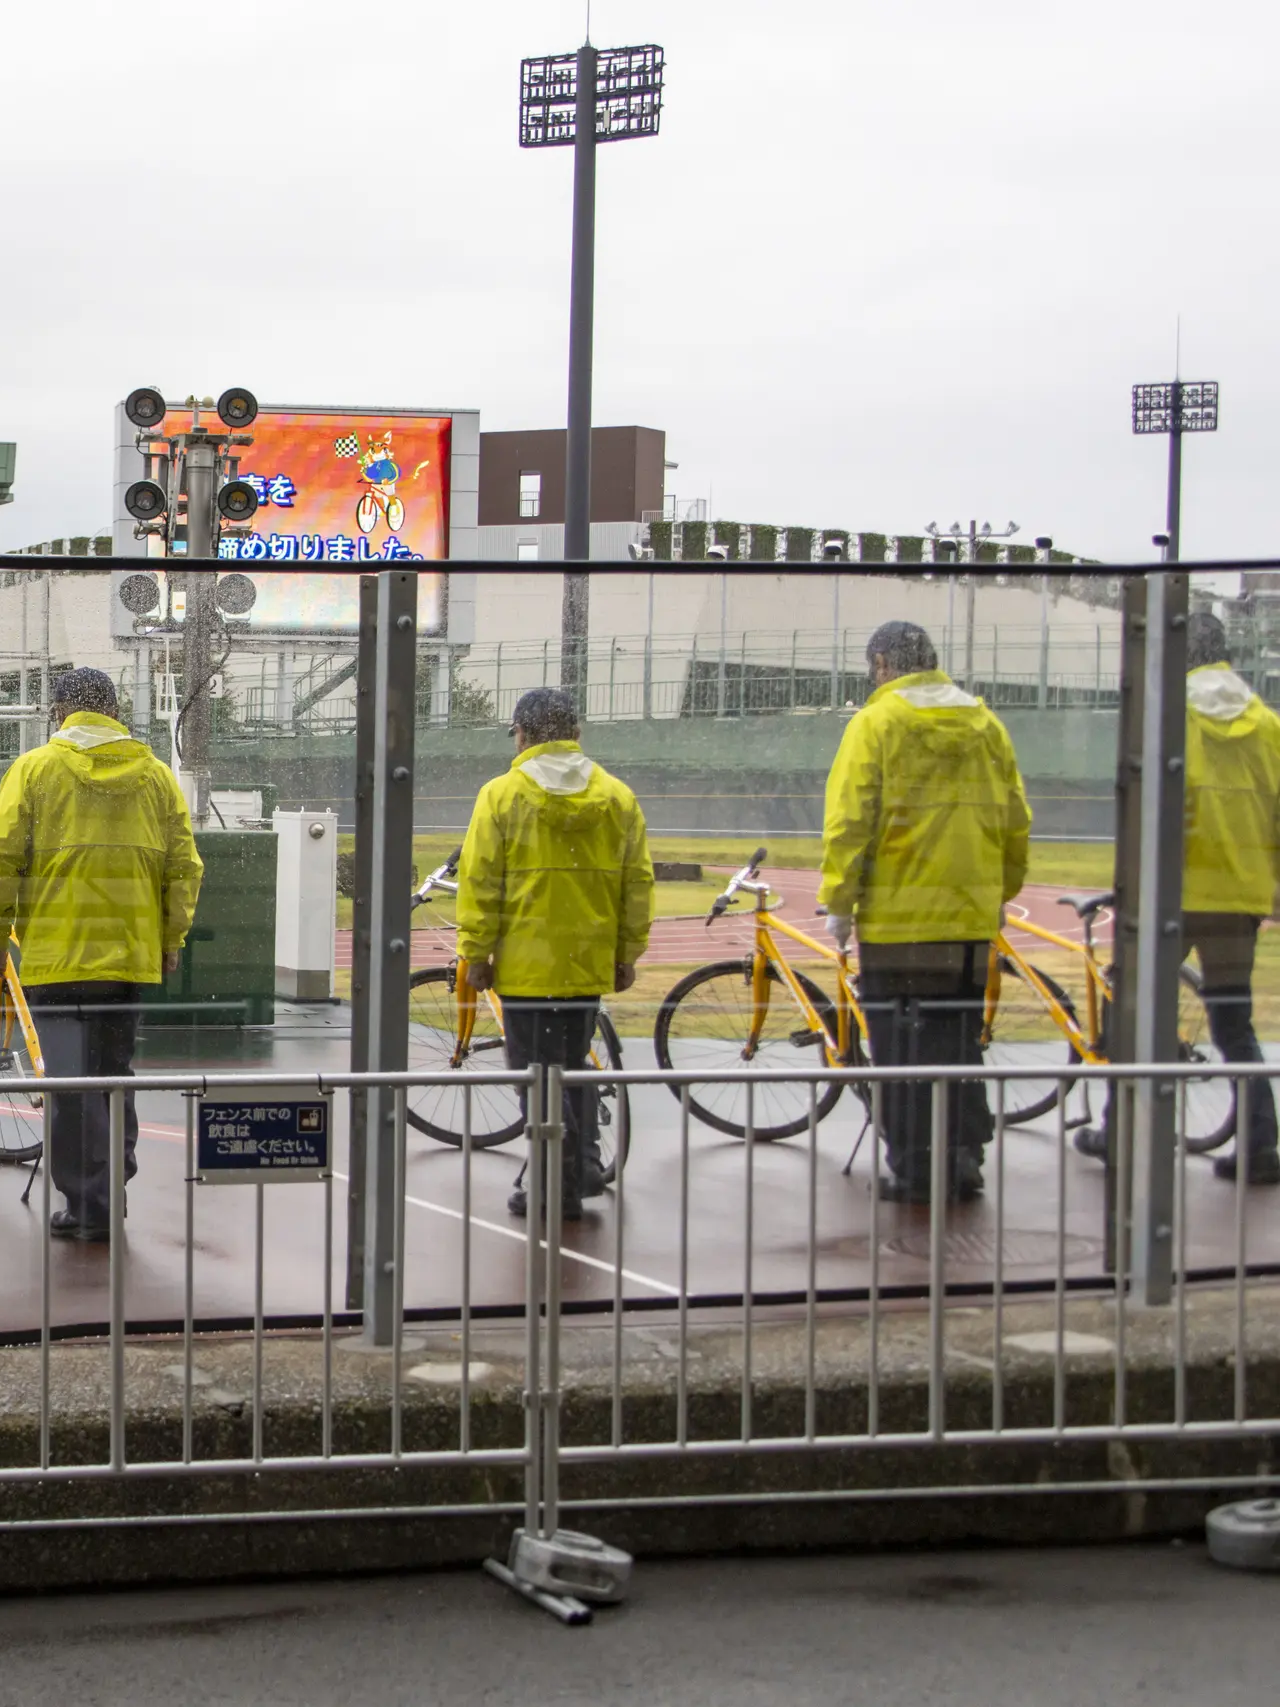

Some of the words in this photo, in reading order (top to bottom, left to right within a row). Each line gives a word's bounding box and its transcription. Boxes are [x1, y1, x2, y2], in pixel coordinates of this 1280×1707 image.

[223, 474, 295, 506] 売を
[209, 679, 217, 695] 2
[203, 1107, 291, 1121] フェンス前での
[208, 1124, 250, 1138] 飲食は
[216, 1139, 316, 1155] ご遠慮ください。
